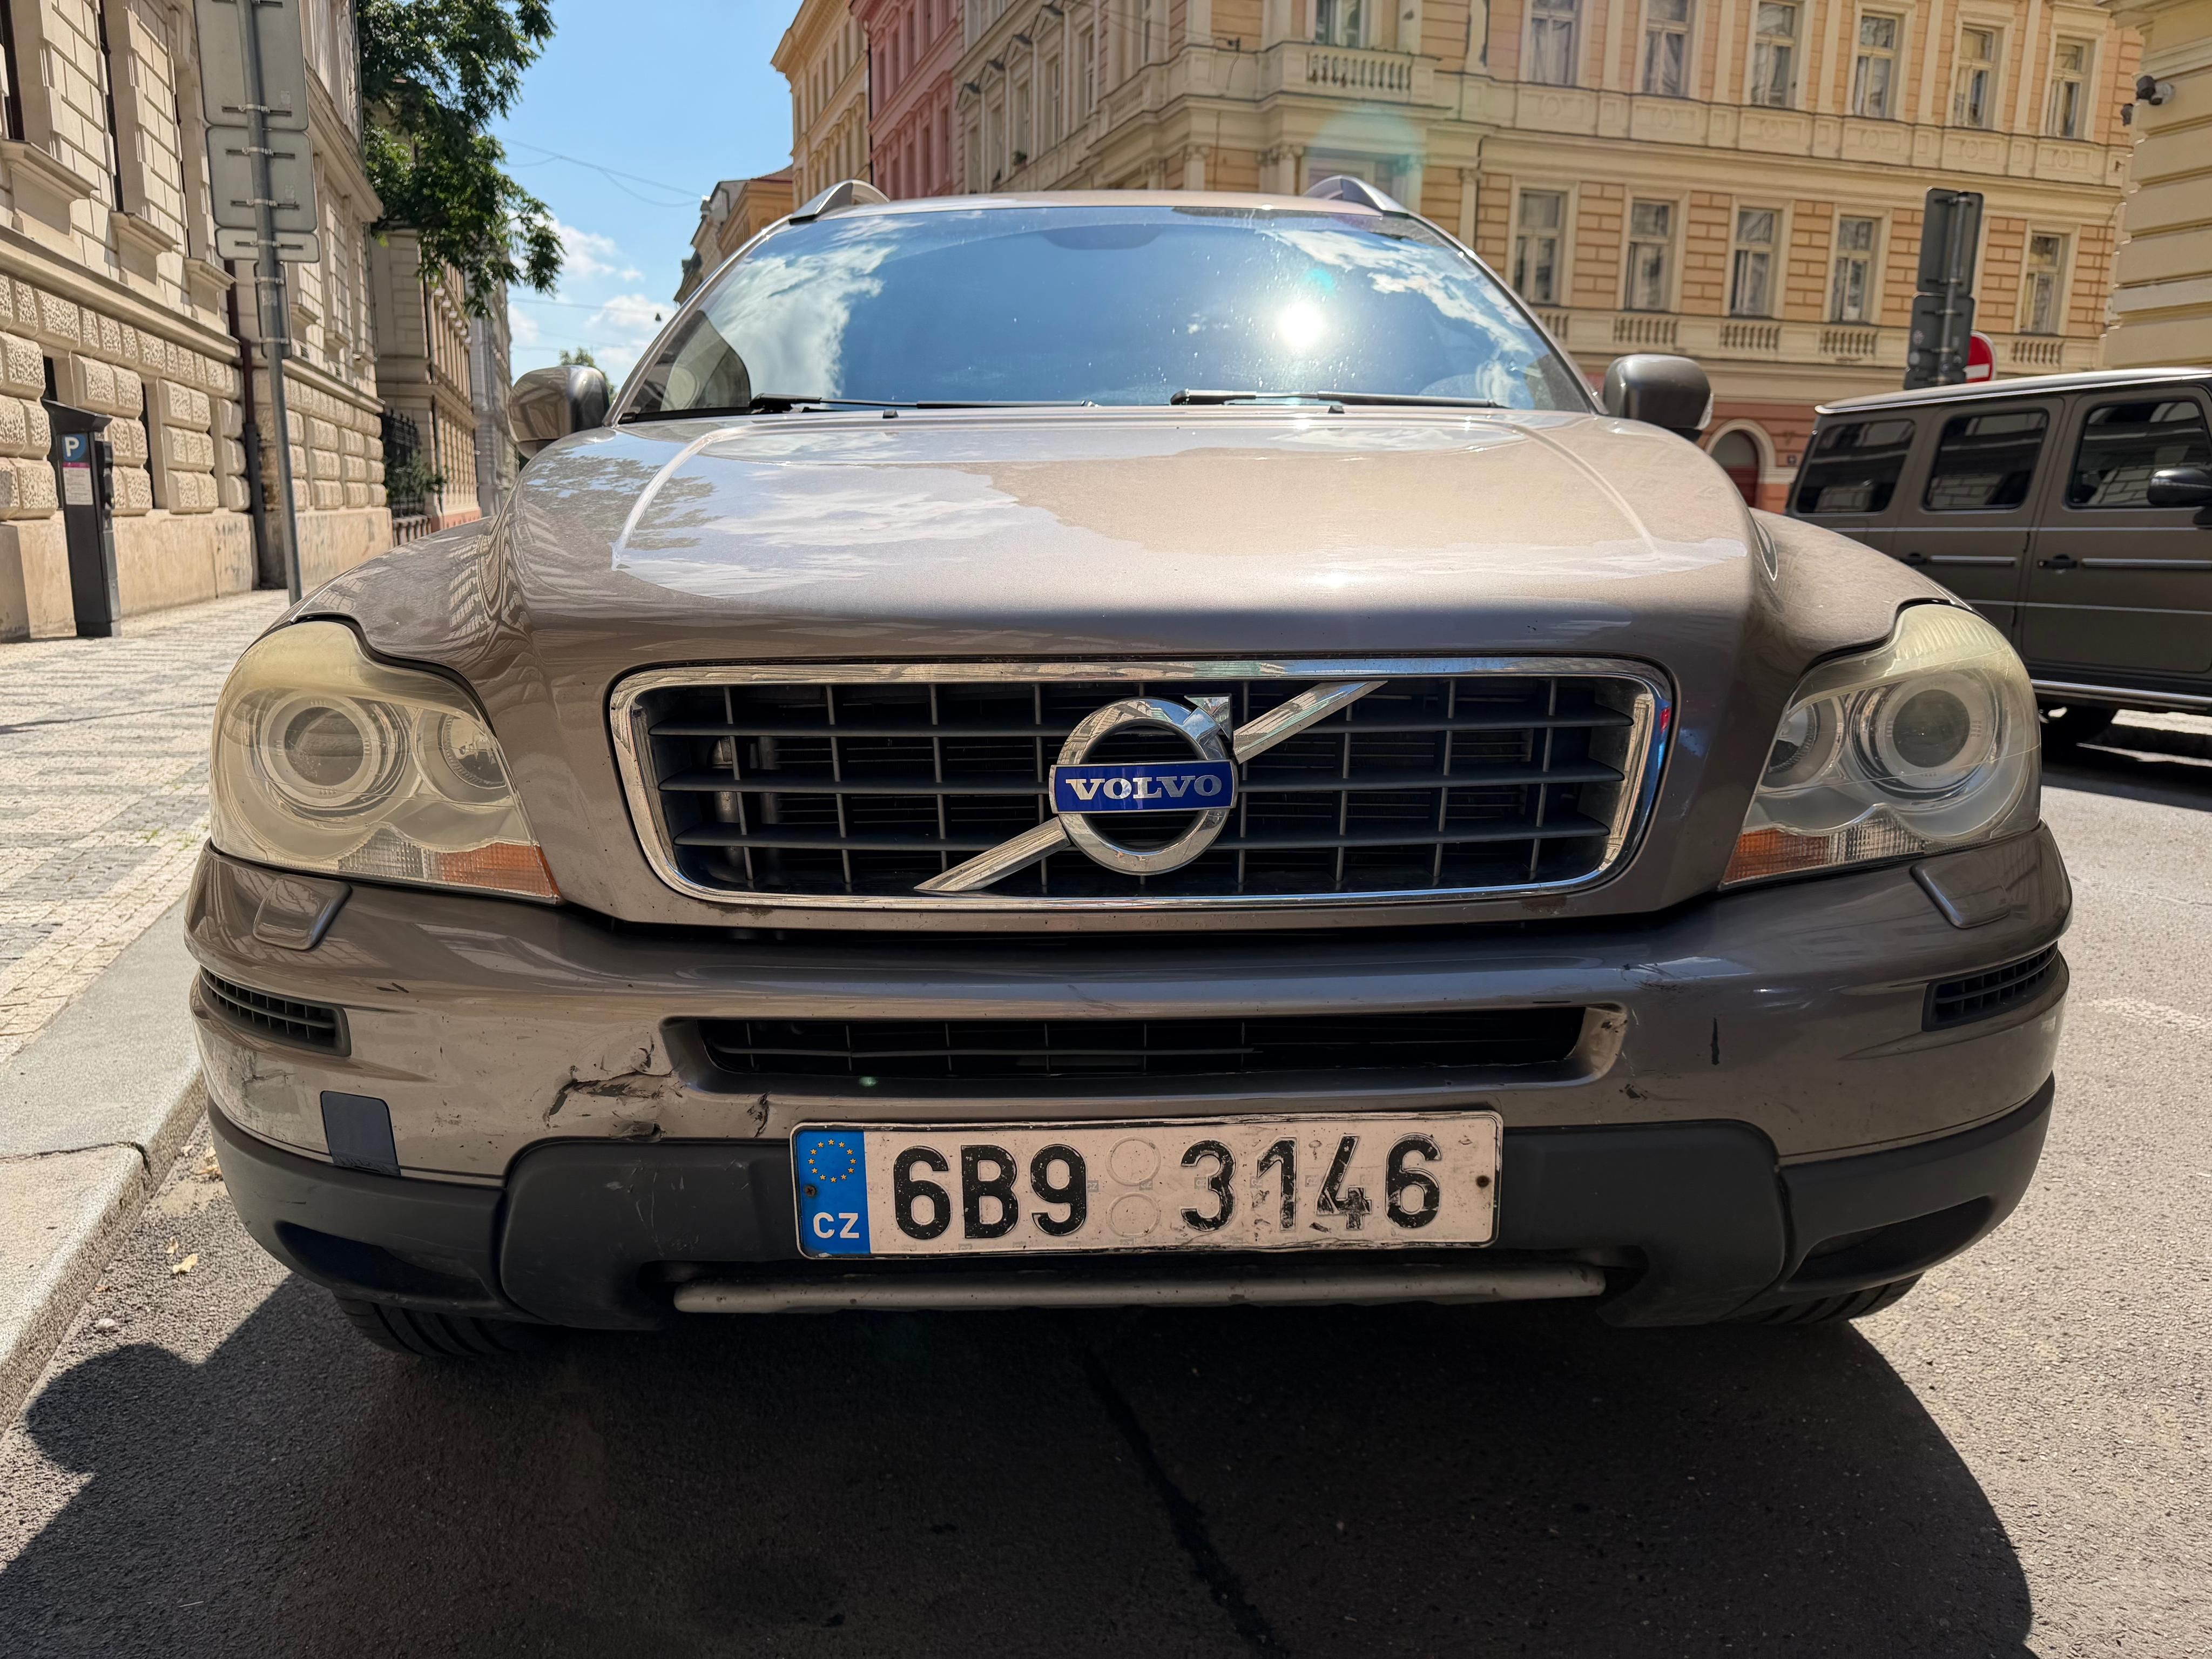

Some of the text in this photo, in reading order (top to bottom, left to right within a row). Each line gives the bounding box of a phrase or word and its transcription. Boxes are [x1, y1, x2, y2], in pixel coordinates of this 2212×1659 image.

[65, 436, 79, 457] P
[1065, 775, 1222, 800] VOLVO
[893, 1132, 1441, 1240] 6B9 3146
[813, 1212, 860, 1239] CZ
